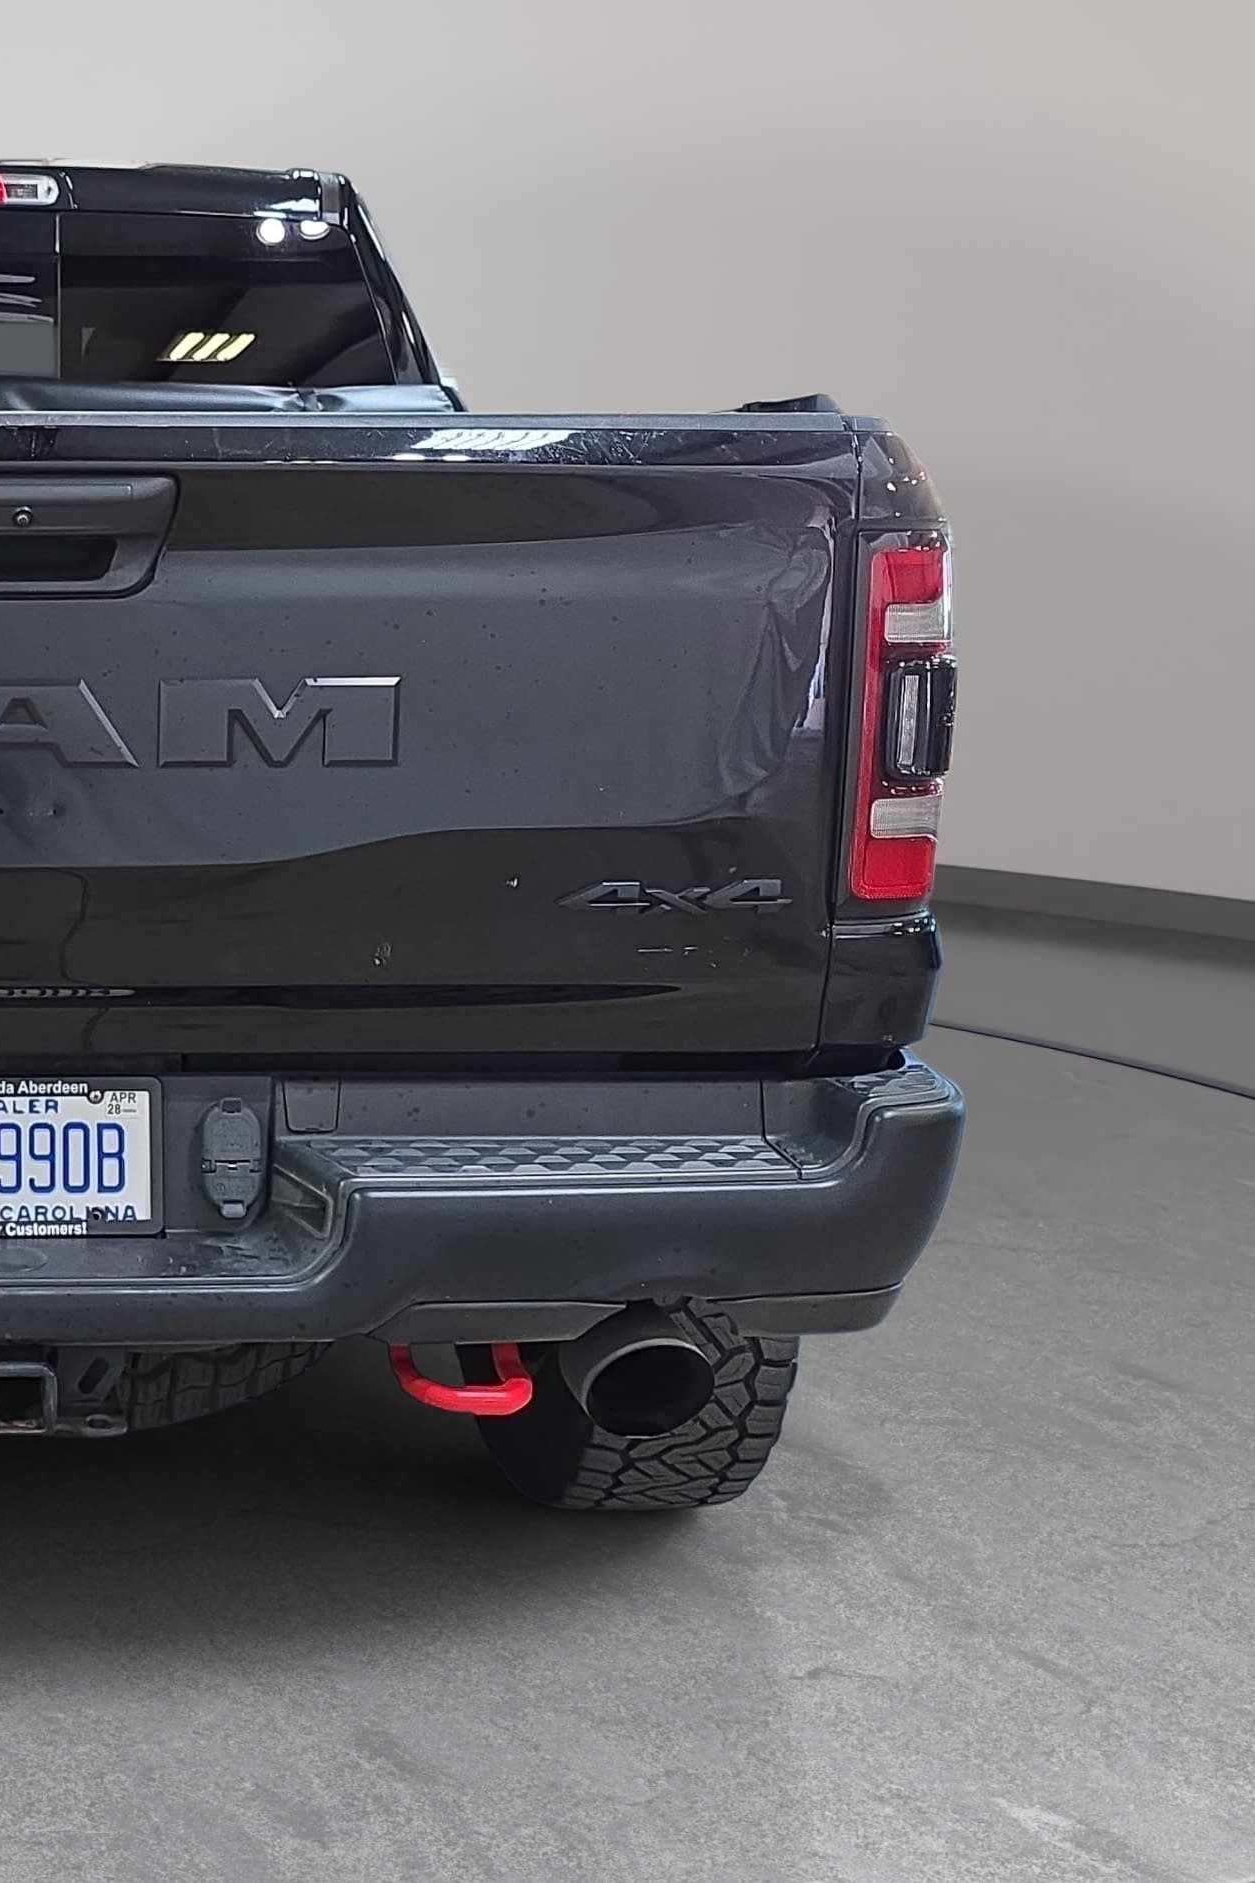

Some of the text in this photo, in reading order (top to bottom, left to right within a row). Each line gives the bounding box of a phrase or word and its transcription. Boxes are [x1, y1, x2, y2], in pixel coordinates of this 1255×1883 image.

[17, 1081, 88, 1094] Aberdeen
[110, 1092, 137, 1103] APR
[107, 1103, 121, 1115] 28
[5, 1221, 87, 1236] Customers!
